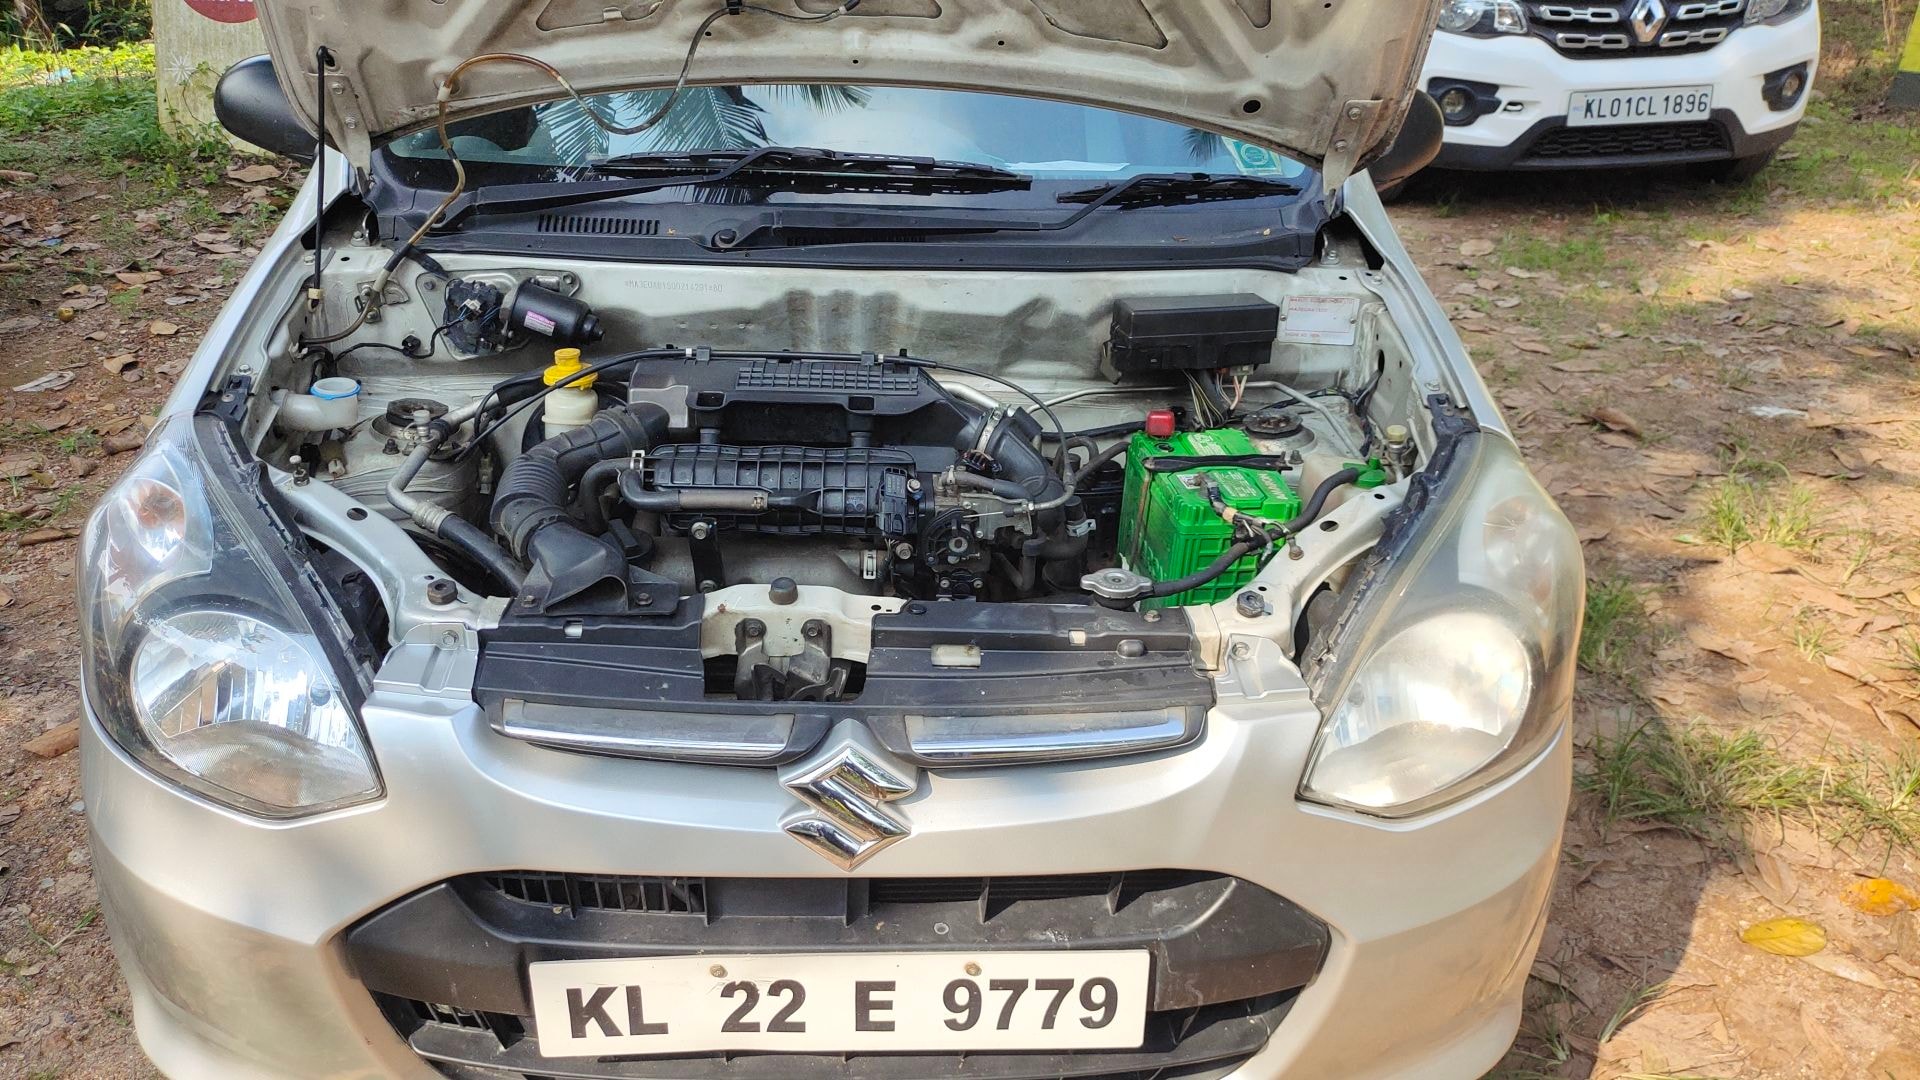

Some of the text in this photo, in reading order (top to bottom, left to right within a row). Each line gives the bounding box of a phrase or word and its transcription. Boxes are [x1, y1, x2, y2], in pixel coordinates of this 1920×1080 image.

[567, 978, 1118, 1038] KL 22 E 9779
